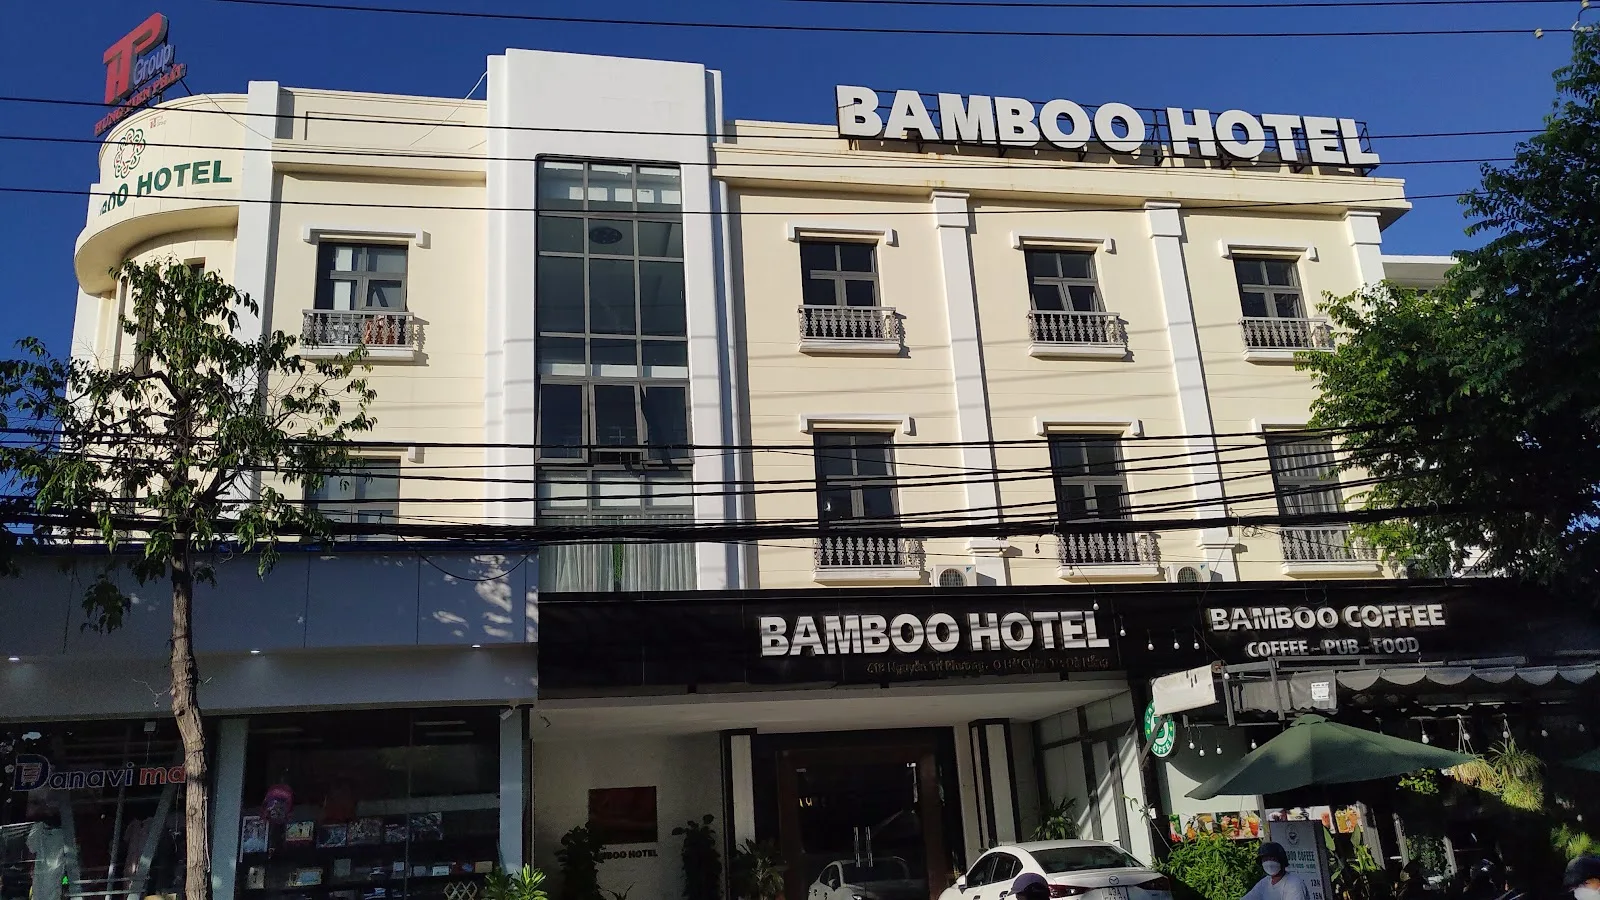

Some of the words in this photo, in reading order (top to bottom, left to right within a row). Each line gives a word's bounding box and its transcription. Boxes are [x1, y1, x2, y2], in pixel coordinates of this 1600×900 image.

[133, 43, 172, 85] Group
[836, 84, 1146, 153] BAMBOO
[1166, 106, 1381, 166] HOTEL
[136, 160, 232, 198] HOTEL
[760, 612, 960, 656] BAMBOO
[969, 610, 1110, 651] HOTEL
[1209, 606, 1339, 631] BAMBOO
[1344, 604, 1446, 628] COFFEE
[1247, 640, 1308, 658] COFFEE
[1324, 637, 1360, 656] PUB
[1373, 637, 1420, 654] FOOD
[12, 754, 136, 791] Danavi
[628, 849, 658, 859] HOTEL
